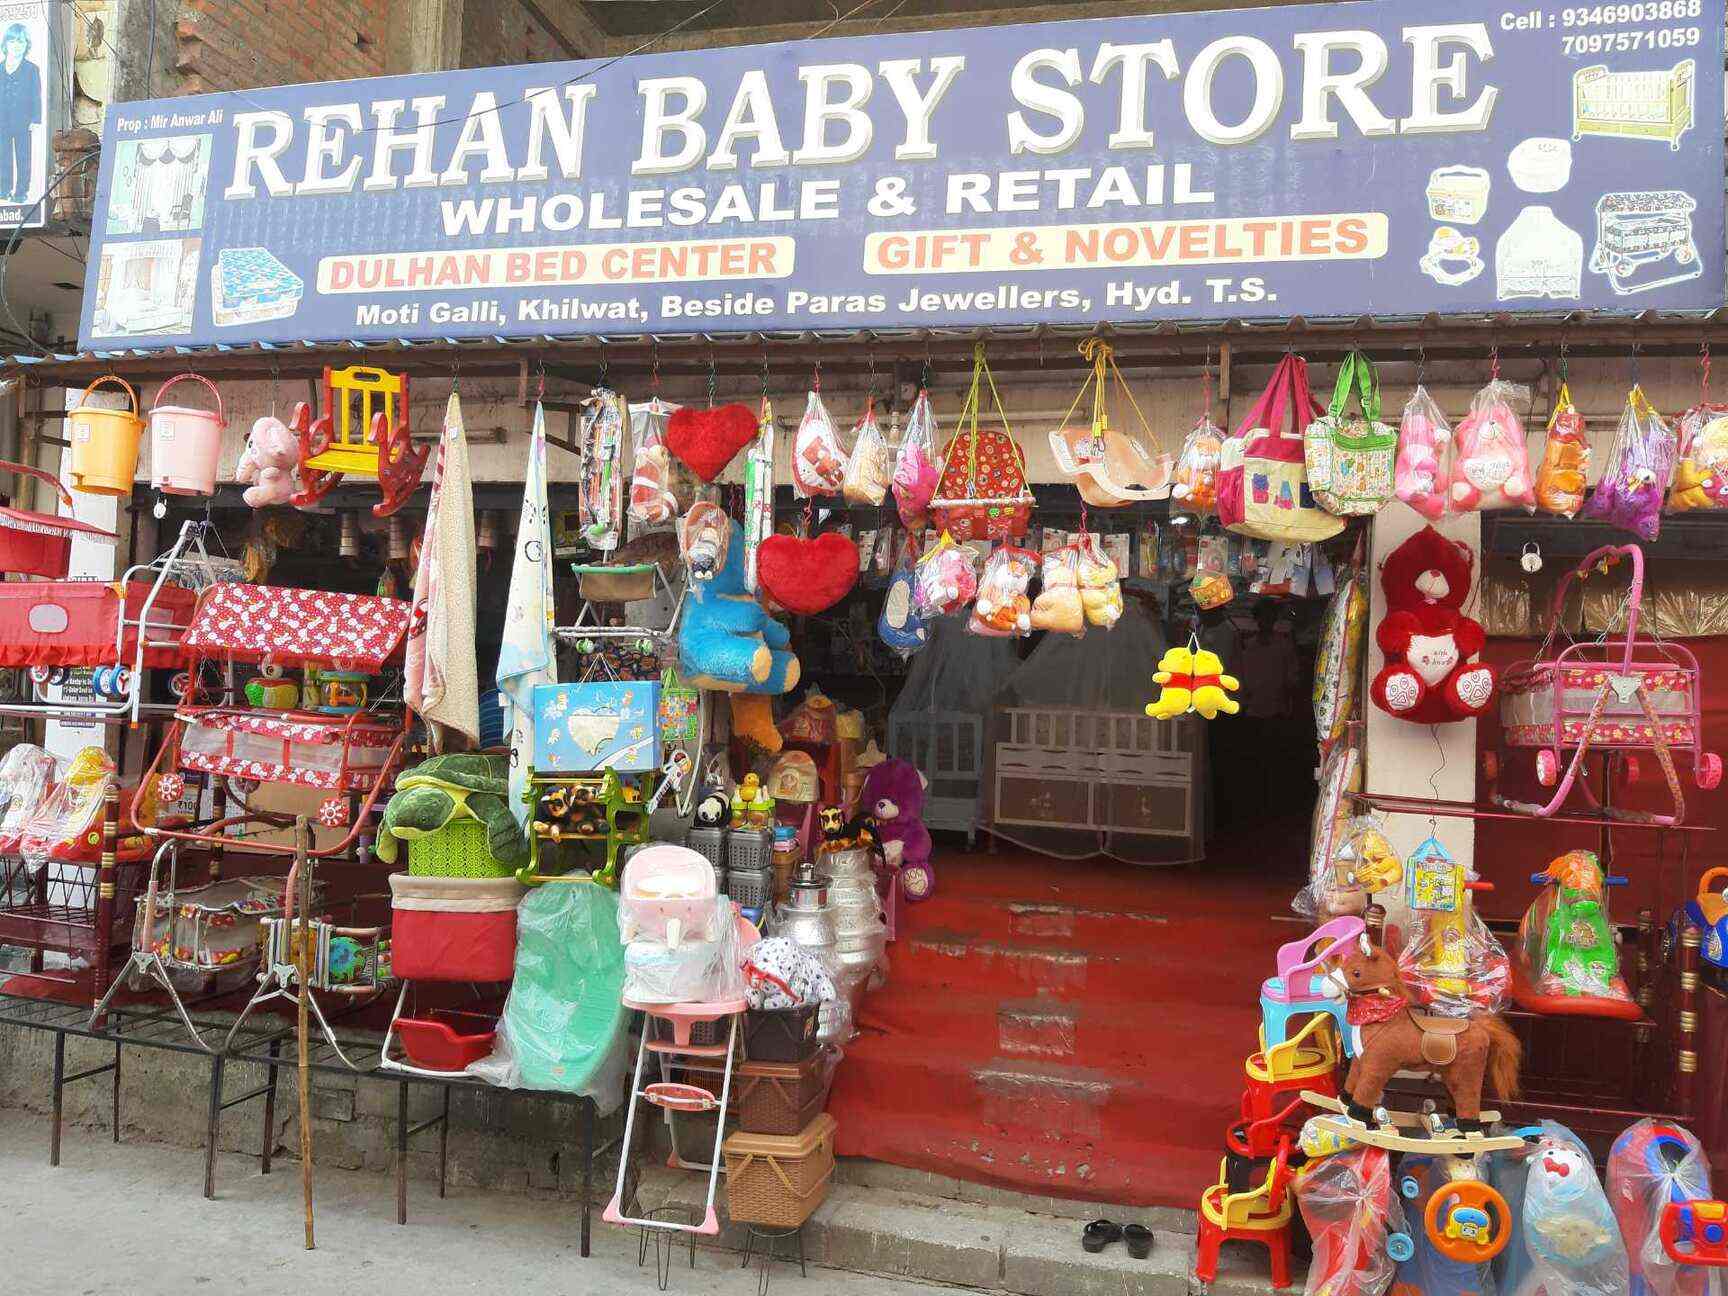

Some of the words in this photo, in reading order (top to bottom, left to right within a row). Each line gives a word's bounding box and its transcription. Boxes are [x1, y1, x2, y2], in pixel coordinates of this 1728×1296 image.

[1501, 12, 1542, 30] Cell
[1562, 0, 1701, 28] 9346903868
[1562, 27, 1700, 55] 7097571059
[117, 116, 141, 133] Prop
[151, 113, 168, 129] Mir
[170, 112, 206, 128] Anwar
[207, 109, 224, 124] Ali
[224, 84, 597, 200] REHAN
[631, 56, 966, 175] BABY
[1007, 22, 1500, 154] STORE
[440, 178, 840, 235] WHOLESALE
[867, 176, 917, 216] &
[945, 163, 1215, 214] RETAIL
[329, 249, 499, 290] DULHAN
[505, 246, 587, 283] BED
[602, 242, 778, 280] CENTER
[877, 233, 991, 269] GIFT
[1009, 231, 1045, 265] &
[1065, 218, 1369, 263] NOVELTIES
[356, 302, 418, 326] Moti
[428, 299, 506, 327] Galli,
[516, 295, 648, 323] Khilwat,
[661, 293, 775, 319] Beside
[786, 290, 886, 315] Paras
[898, 285, 1091, 314] Jewellers,
[1106, 281, 1191, 313] Hyd.
[1206, 277, 1277, 304] T.S.
